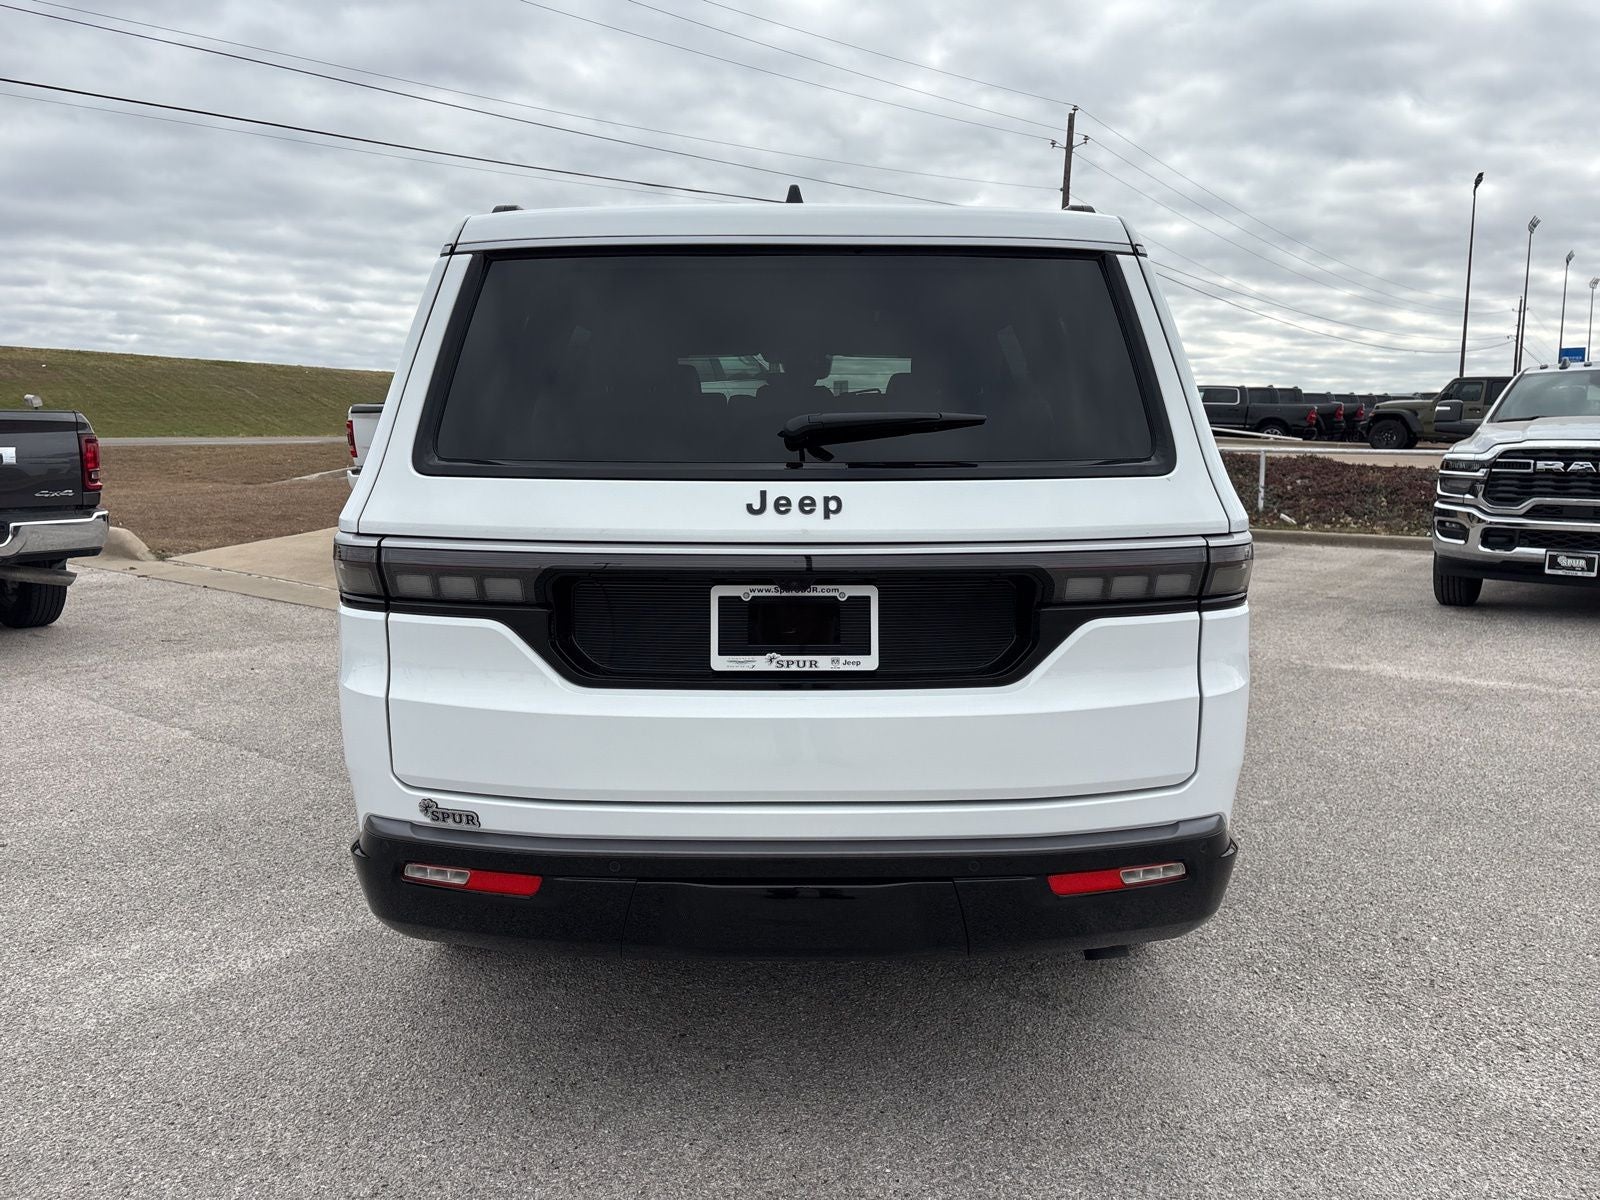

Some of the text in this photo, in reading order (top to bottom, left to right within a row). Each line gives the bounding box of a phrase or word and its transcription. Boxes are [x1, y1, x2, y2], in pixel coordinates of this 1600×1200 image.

[1536, 461, 1600, 472] RA
[746, 489, 842, 520] Jeep
[776, 659, 820, 669] SPUR
[431, 810, 477, 825] SPUR
